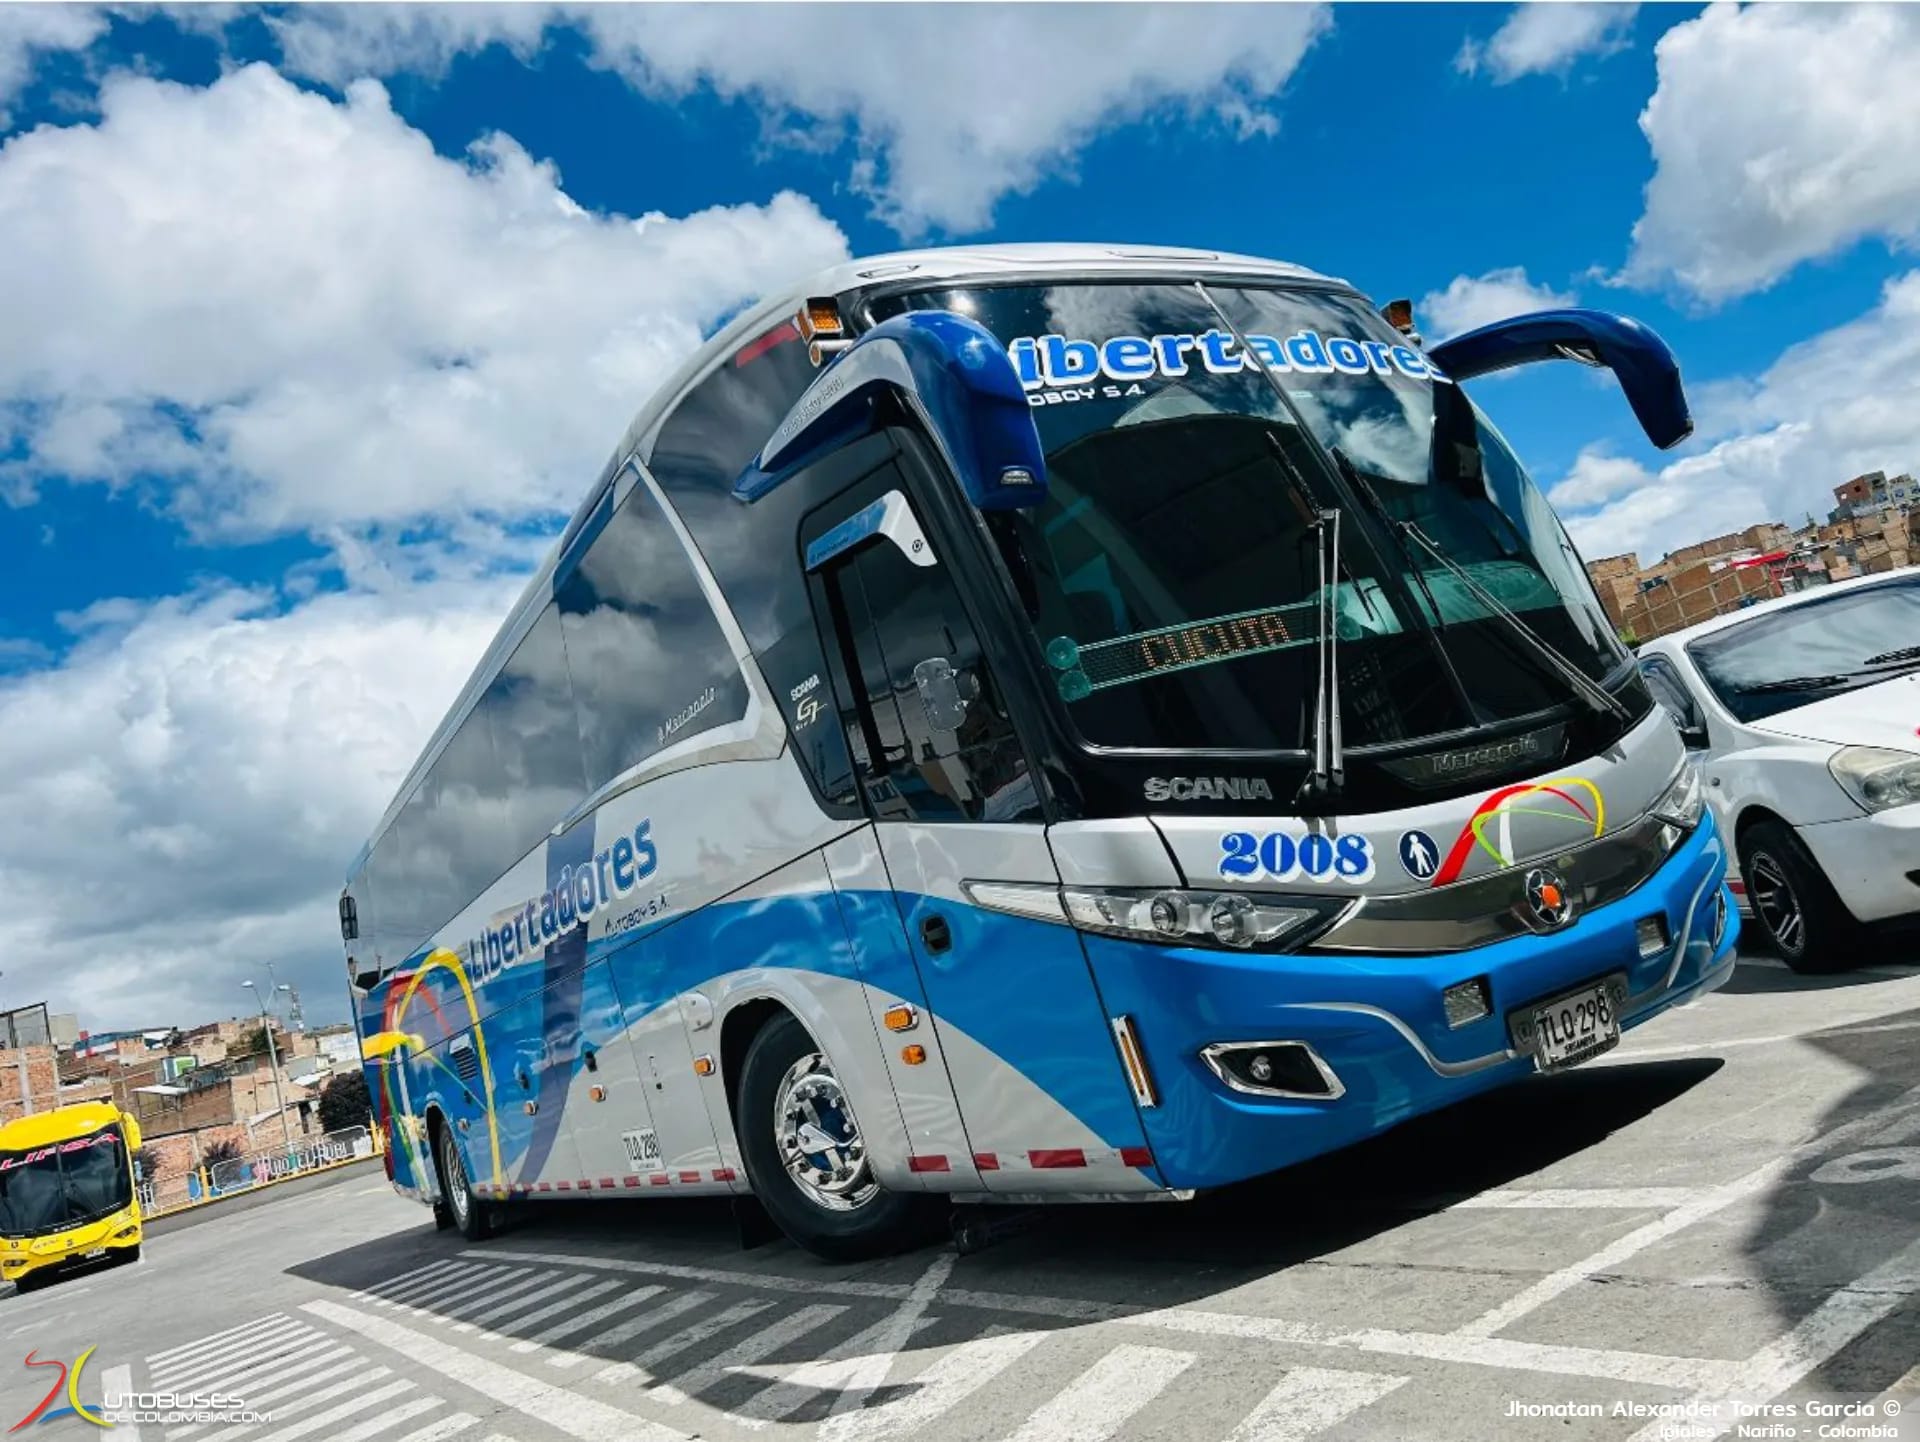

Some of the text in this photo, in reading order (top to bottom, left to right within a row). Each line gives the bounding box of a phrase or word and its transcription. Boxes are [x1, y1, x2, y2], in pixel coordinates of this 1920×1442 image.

[1007, 330, 1453, 390] ibertadore
[1027, 388, 1095, 406] OBOY
[791, 674, 819, 701] SCANIA
[1143, 777, 1273, 801] SCANIA
[1218, 829, 1376, 885] 2008
[469, 816, 658, 984] Libertadores
